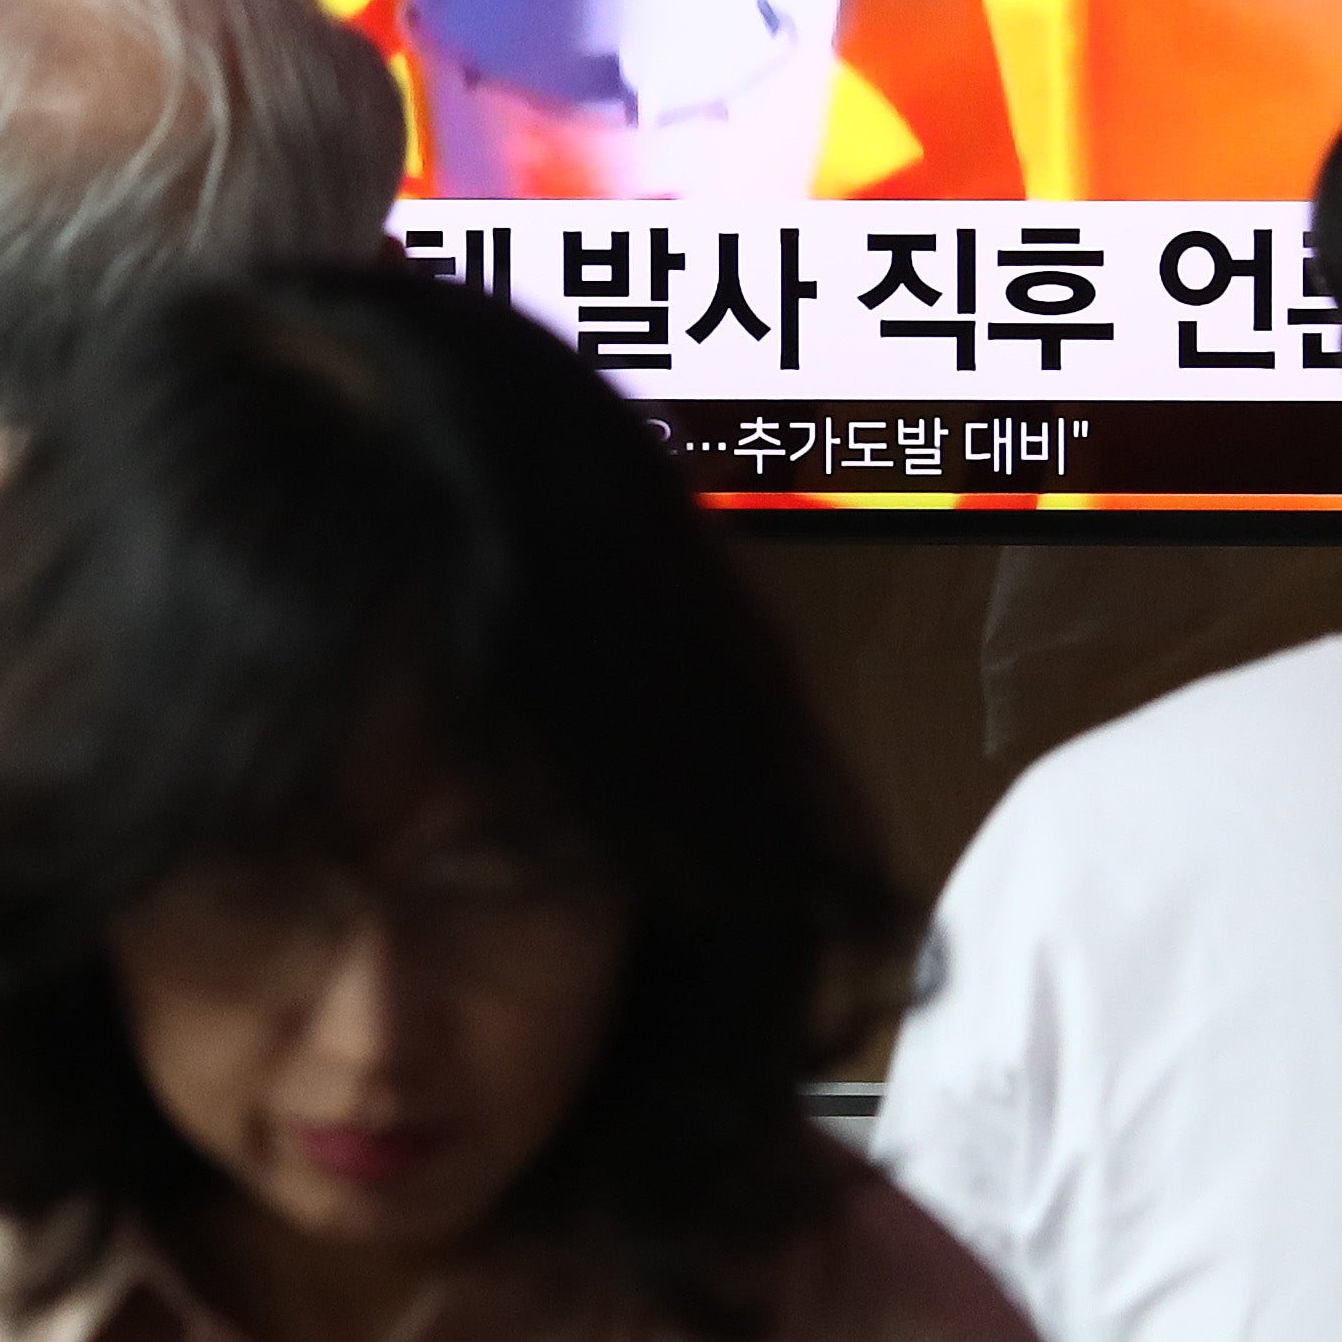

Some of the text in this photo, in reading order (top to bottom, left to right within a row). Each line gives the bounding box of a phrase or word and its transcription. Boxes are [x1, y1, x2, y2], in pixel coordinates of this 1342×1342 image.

[562, 228, 818, 371] 발사
[857, 227, 1115, 372] 직후
[965, 417, 1090, 476] 대비"
